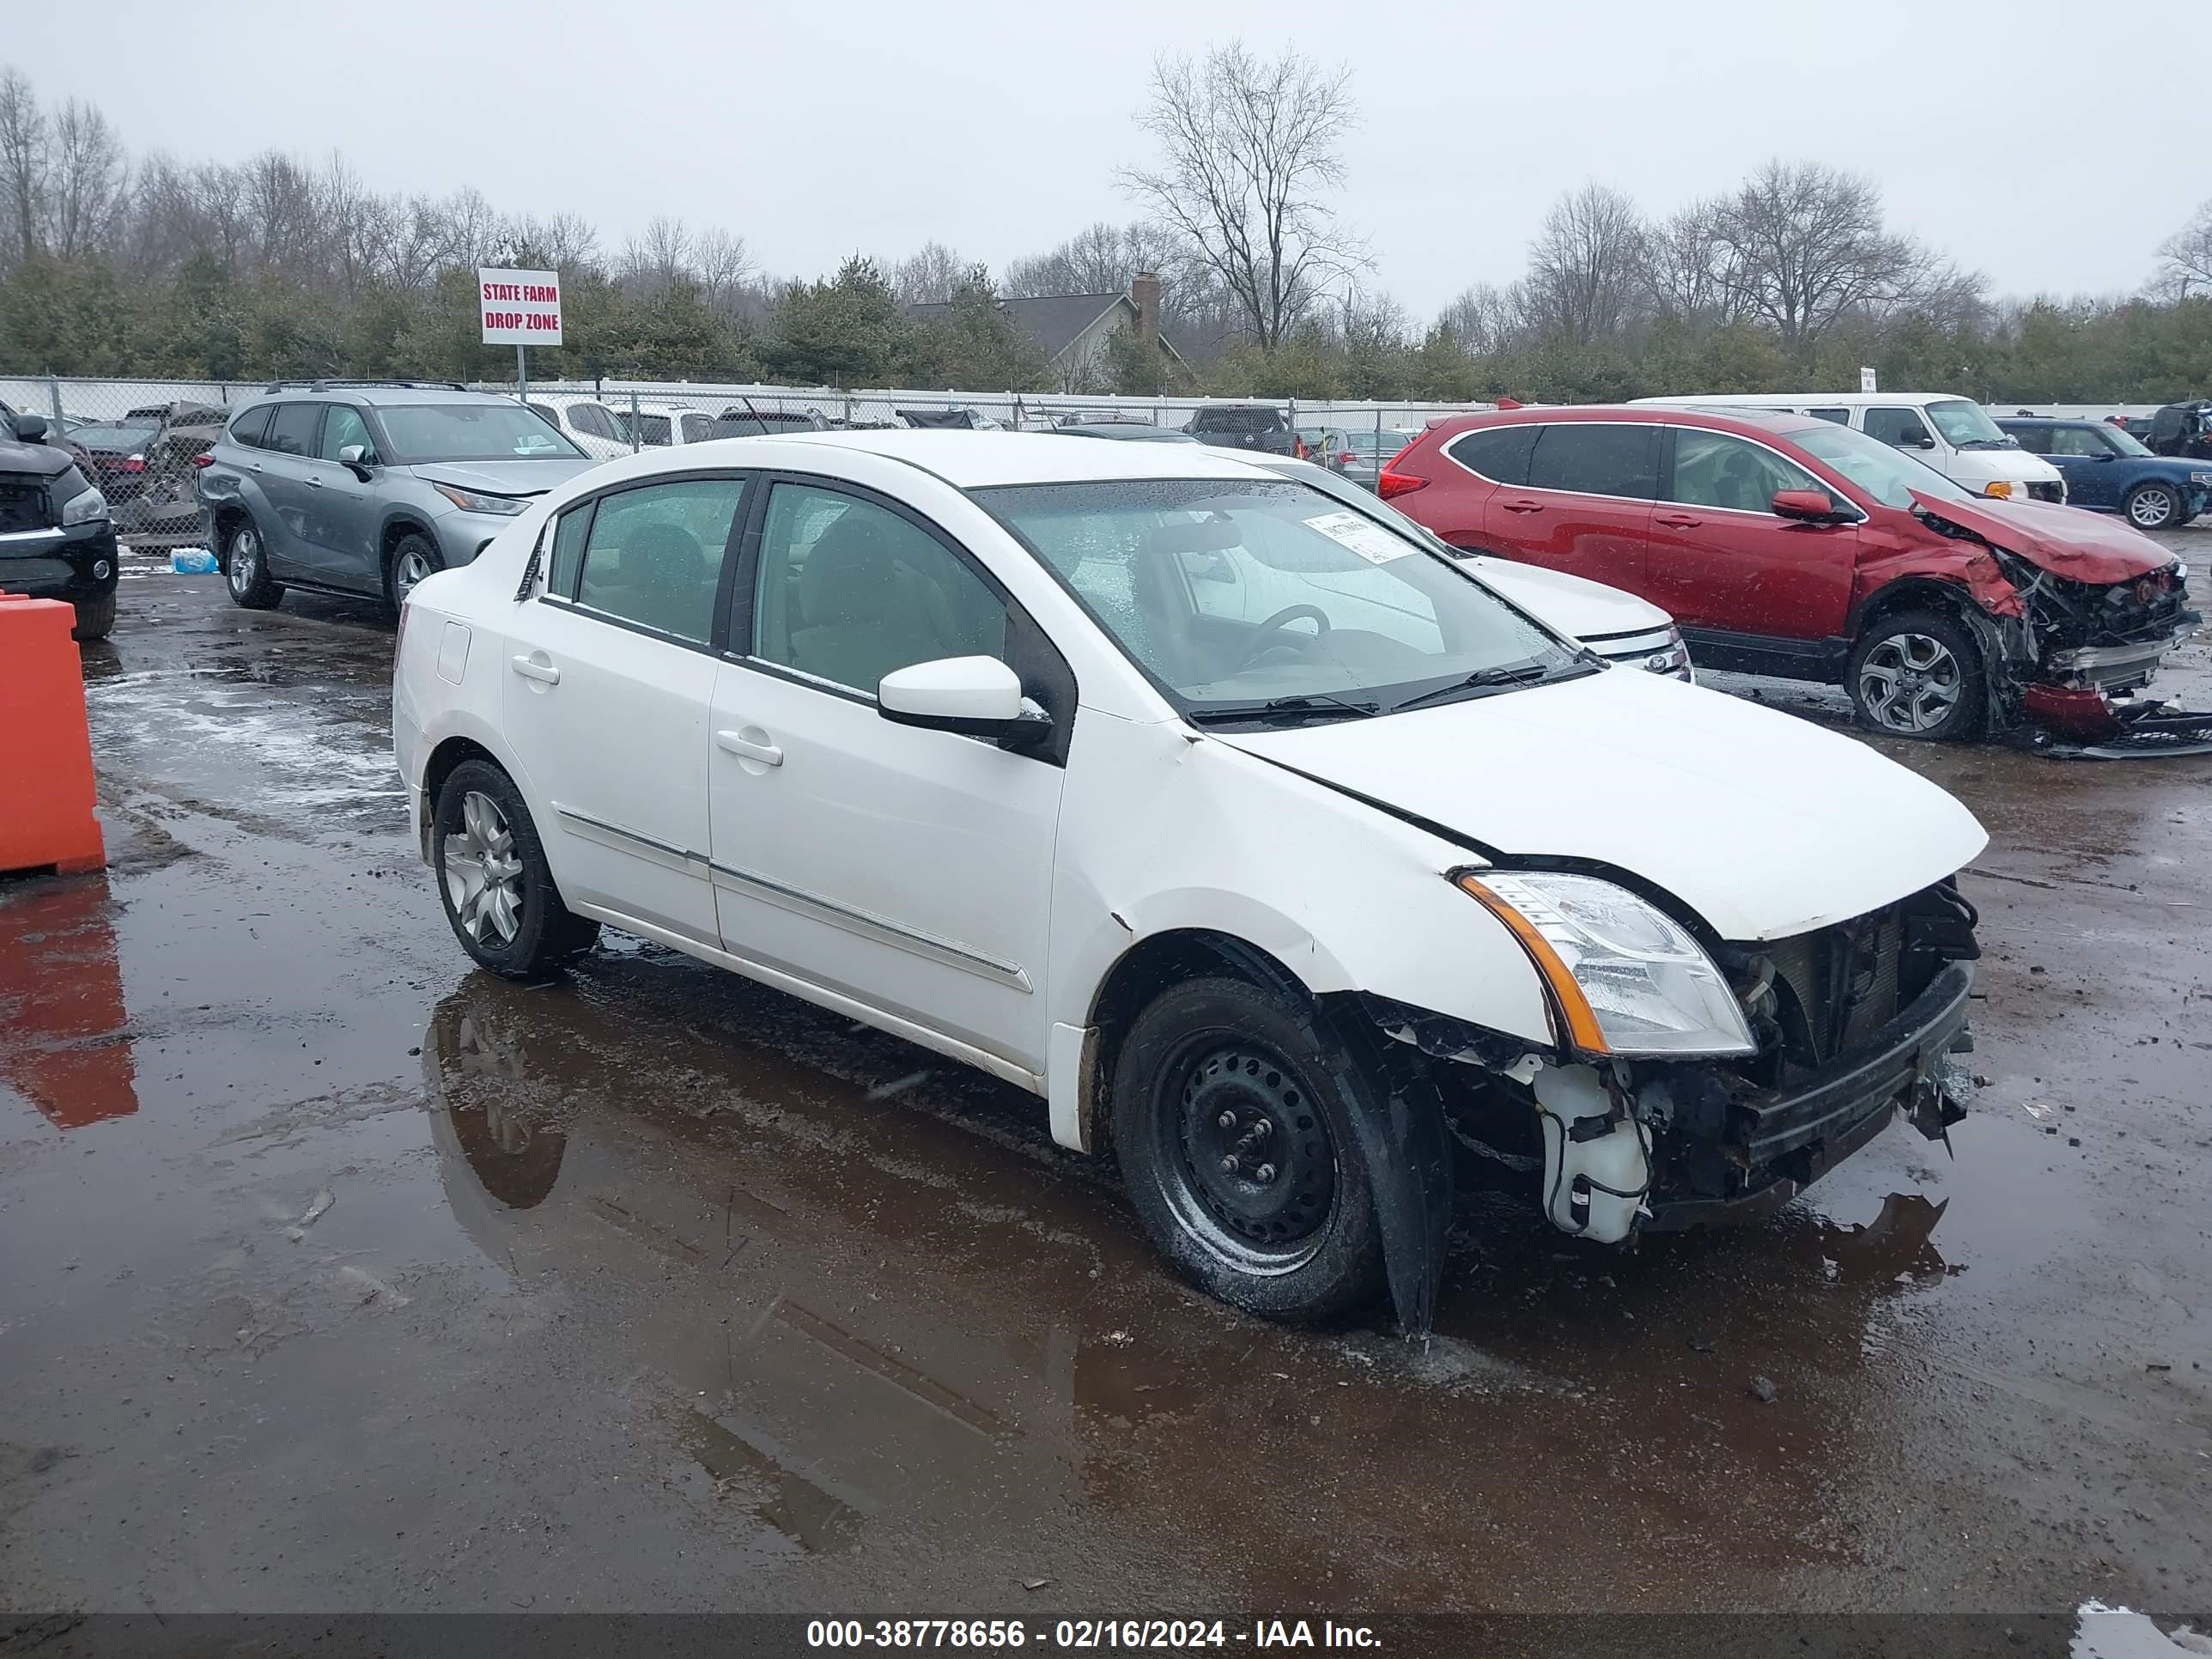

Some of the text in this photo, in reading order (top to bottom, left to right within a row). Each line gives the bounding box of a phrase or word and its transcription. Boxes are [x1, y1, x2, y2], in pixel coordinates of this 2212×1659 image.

[483, 283, 557, 302] STATE FARM
[485, 312, 559, 331] DROP ZONE
